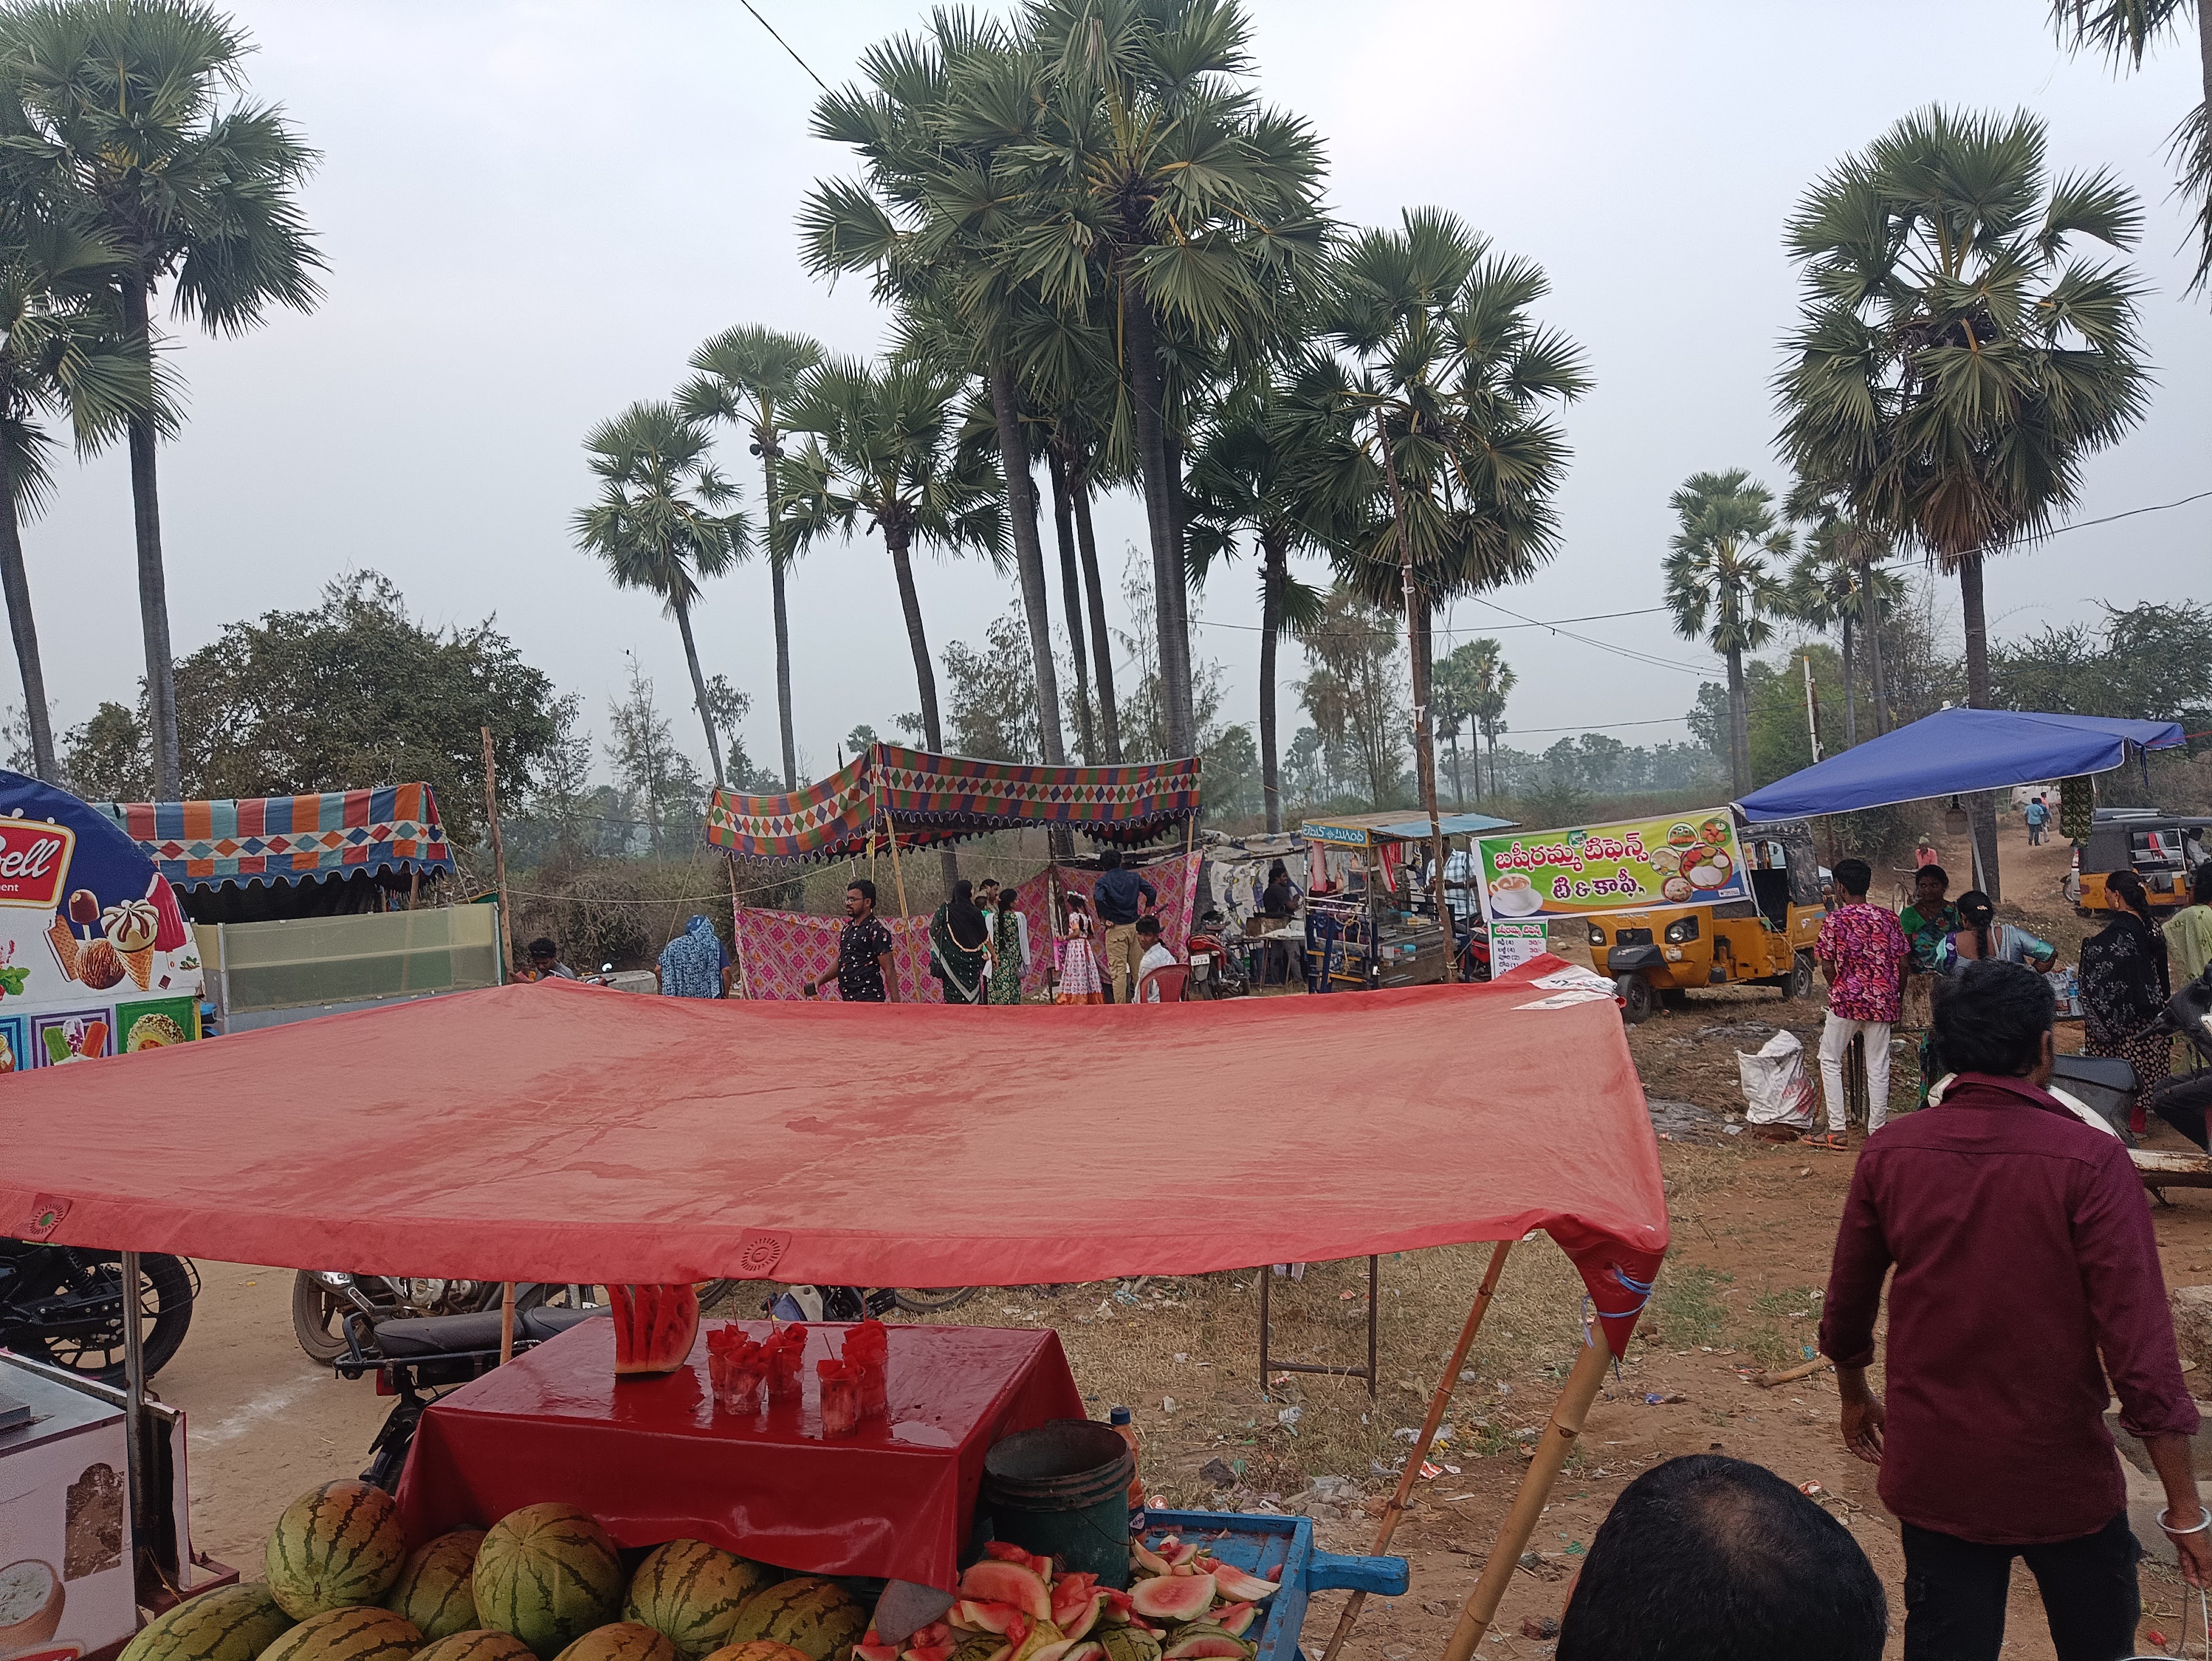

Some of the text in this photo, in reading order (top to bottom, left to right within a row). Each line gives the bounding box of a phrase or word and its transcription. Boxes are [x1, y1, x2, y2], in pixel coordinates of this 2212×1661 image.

[0, 835, 61, 878] ell
[1495, 833, 1649, 872] బషీరమ్మ టిఫెన్స్
[0, 884, 19, 892] ent
